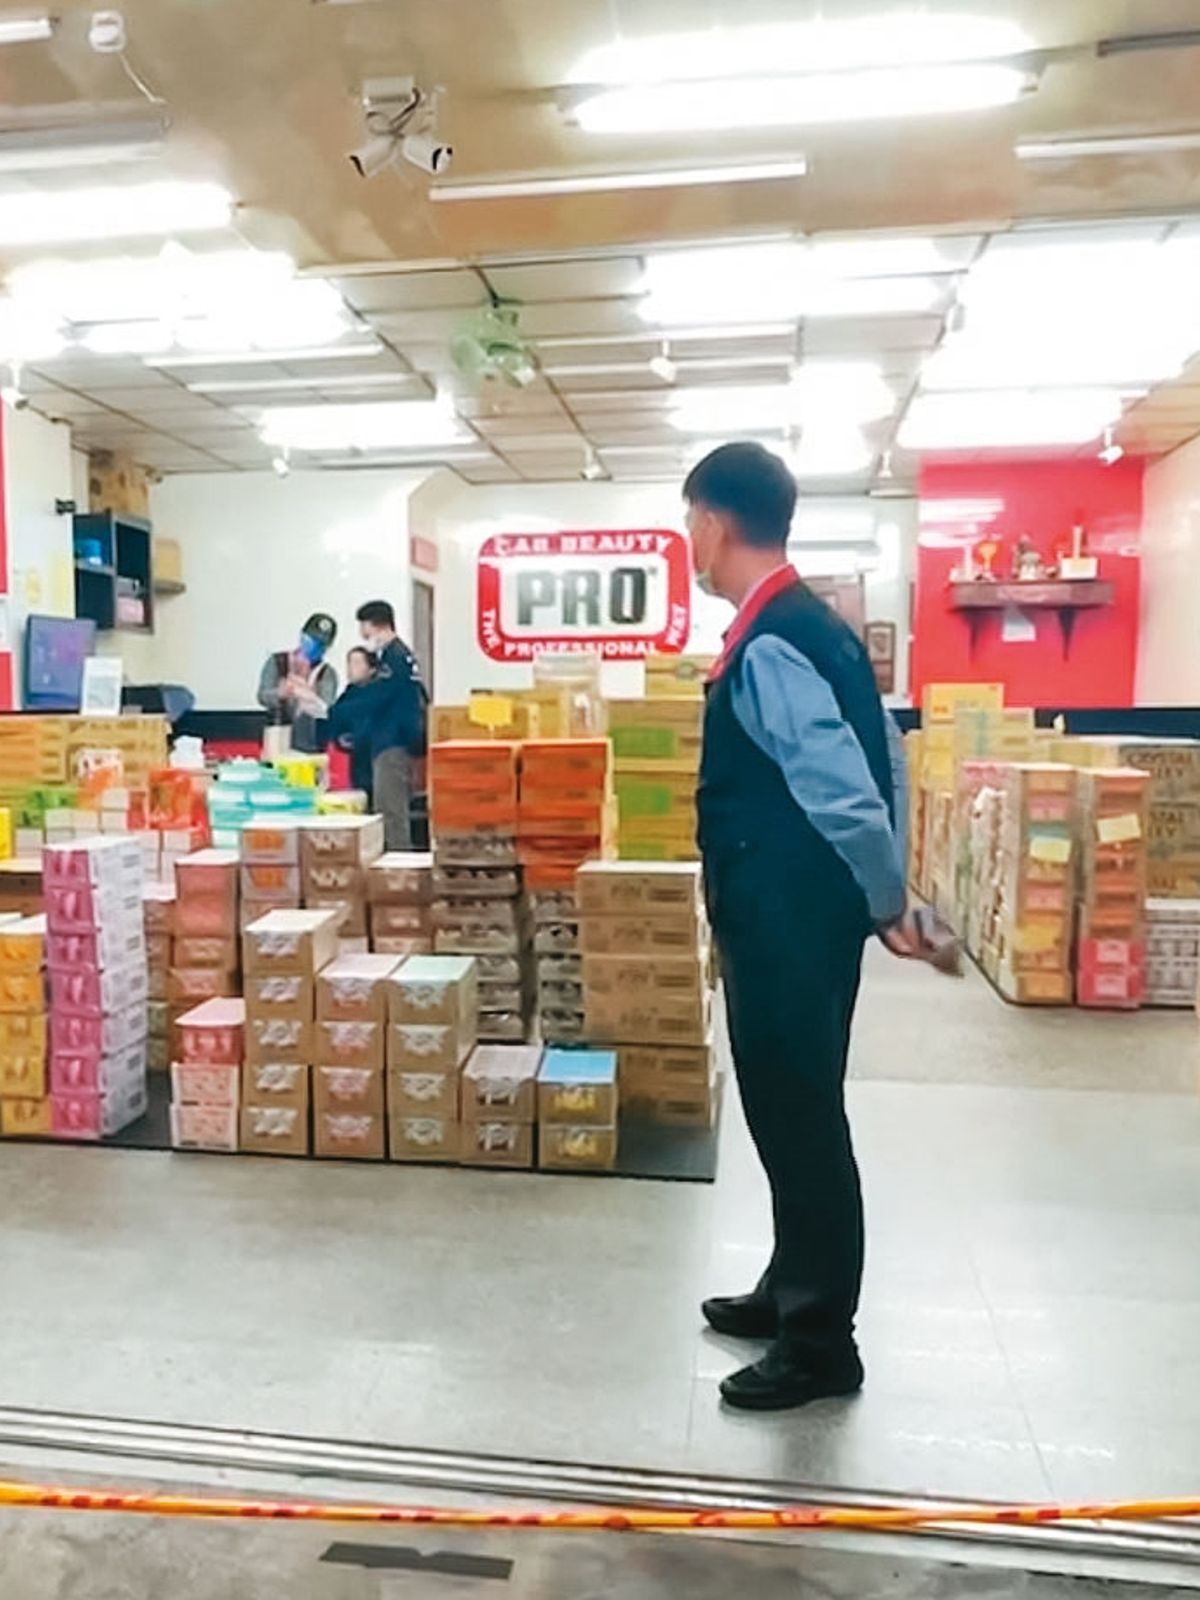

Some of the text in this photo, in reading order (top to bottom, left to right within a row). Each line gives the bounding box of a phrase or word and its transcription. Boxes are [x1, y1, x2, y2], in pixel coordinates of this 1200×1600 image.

[494, 533, 673, 556] CAR BEAUTY
[516, 566, 647, 626] PRO
